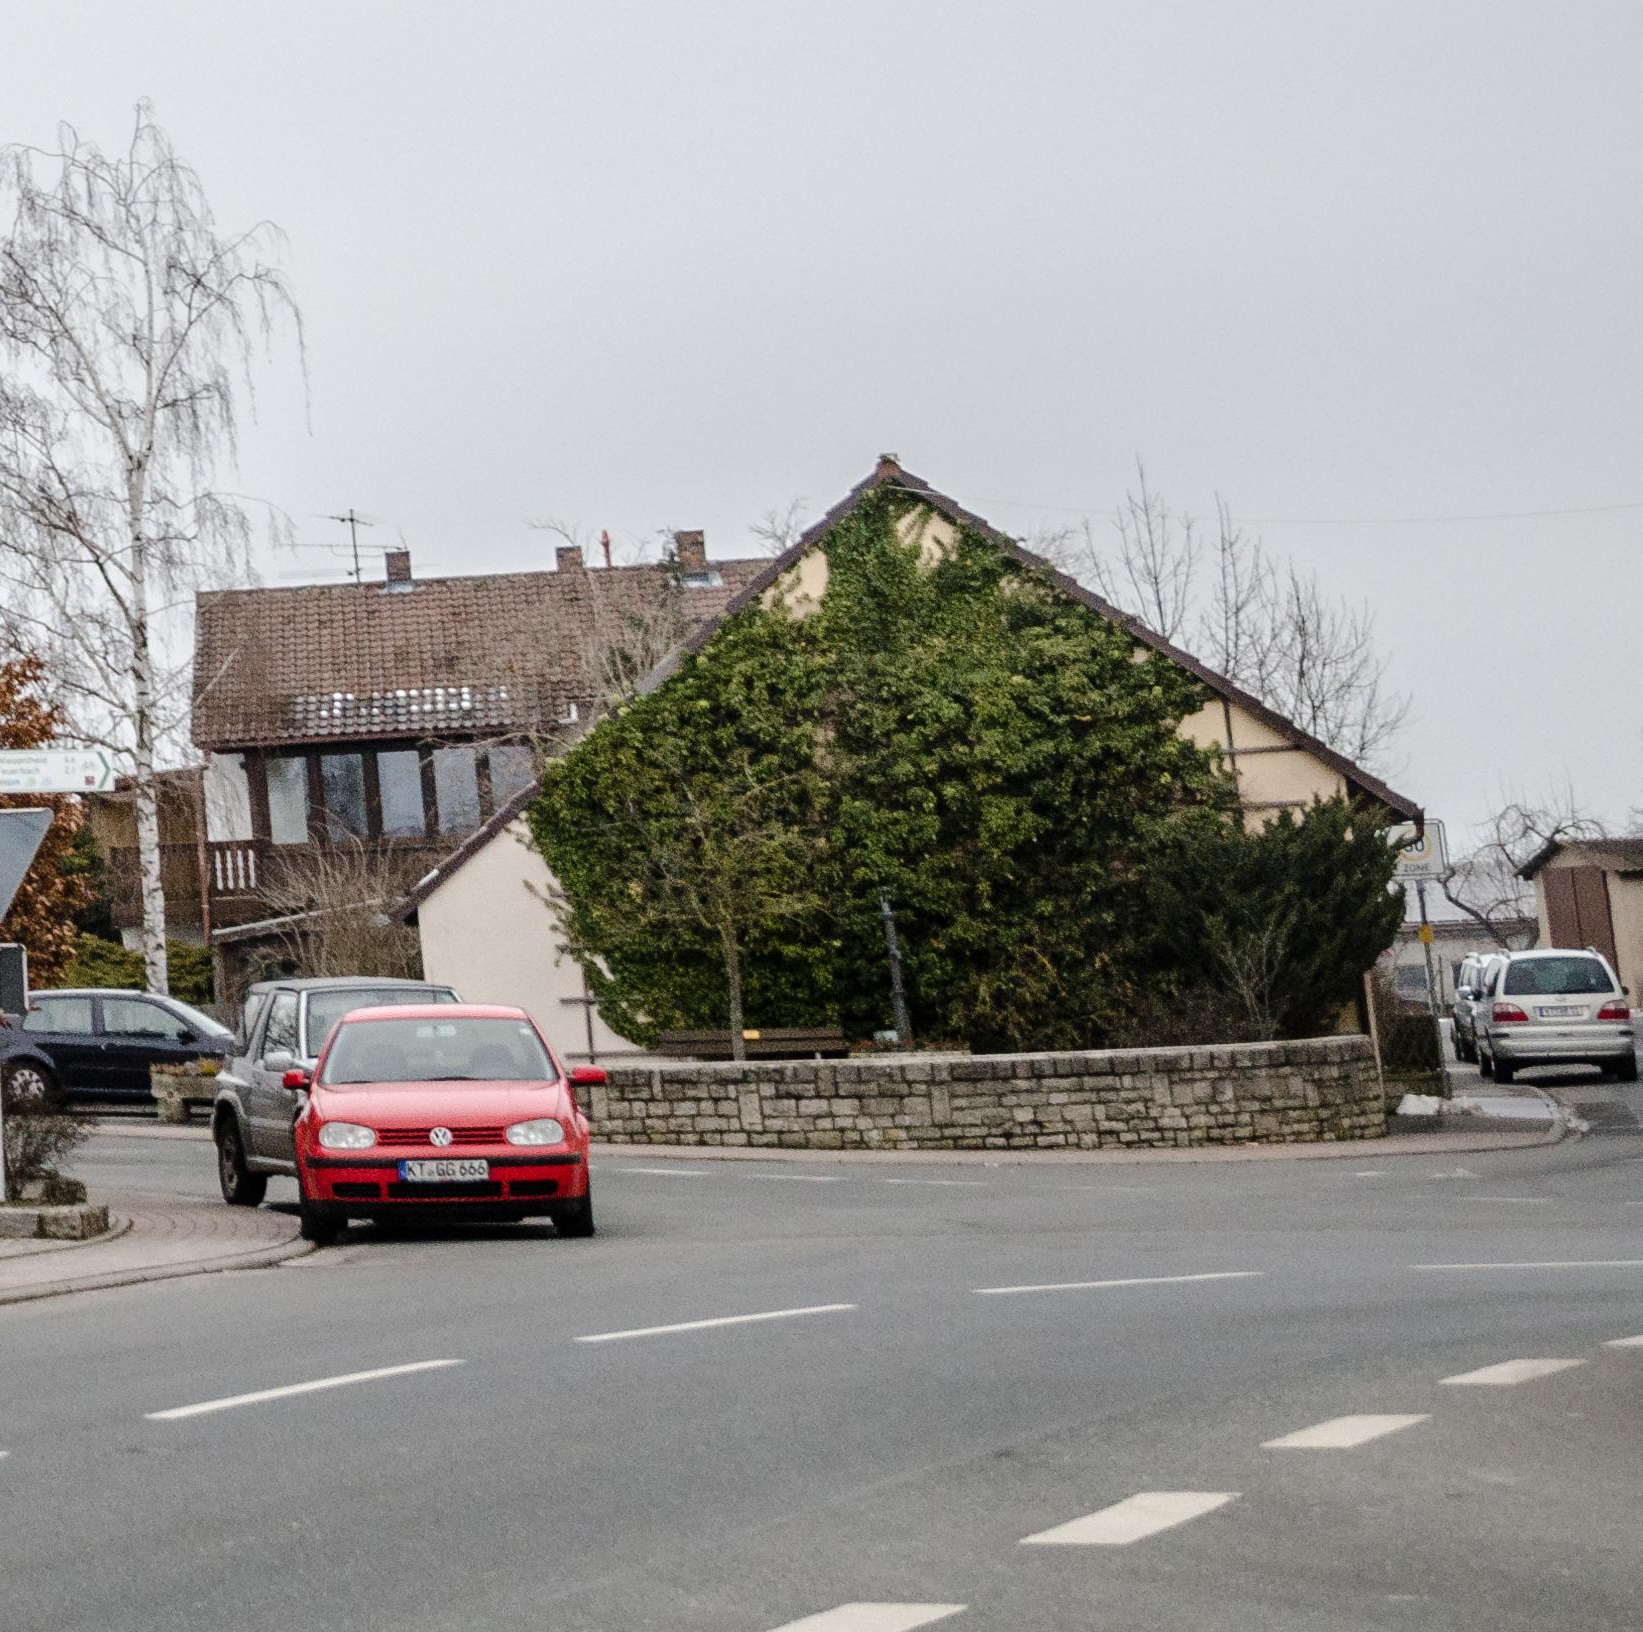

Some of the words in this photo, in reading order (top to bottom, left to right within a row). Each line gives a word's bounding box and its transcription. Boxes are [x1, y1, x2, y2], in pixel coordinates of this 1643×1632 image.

[1404, 863, 1428, 873] ZONE
[407, 1162, 425, 1176] KT
[459, 1162, 486, 1176] 666
